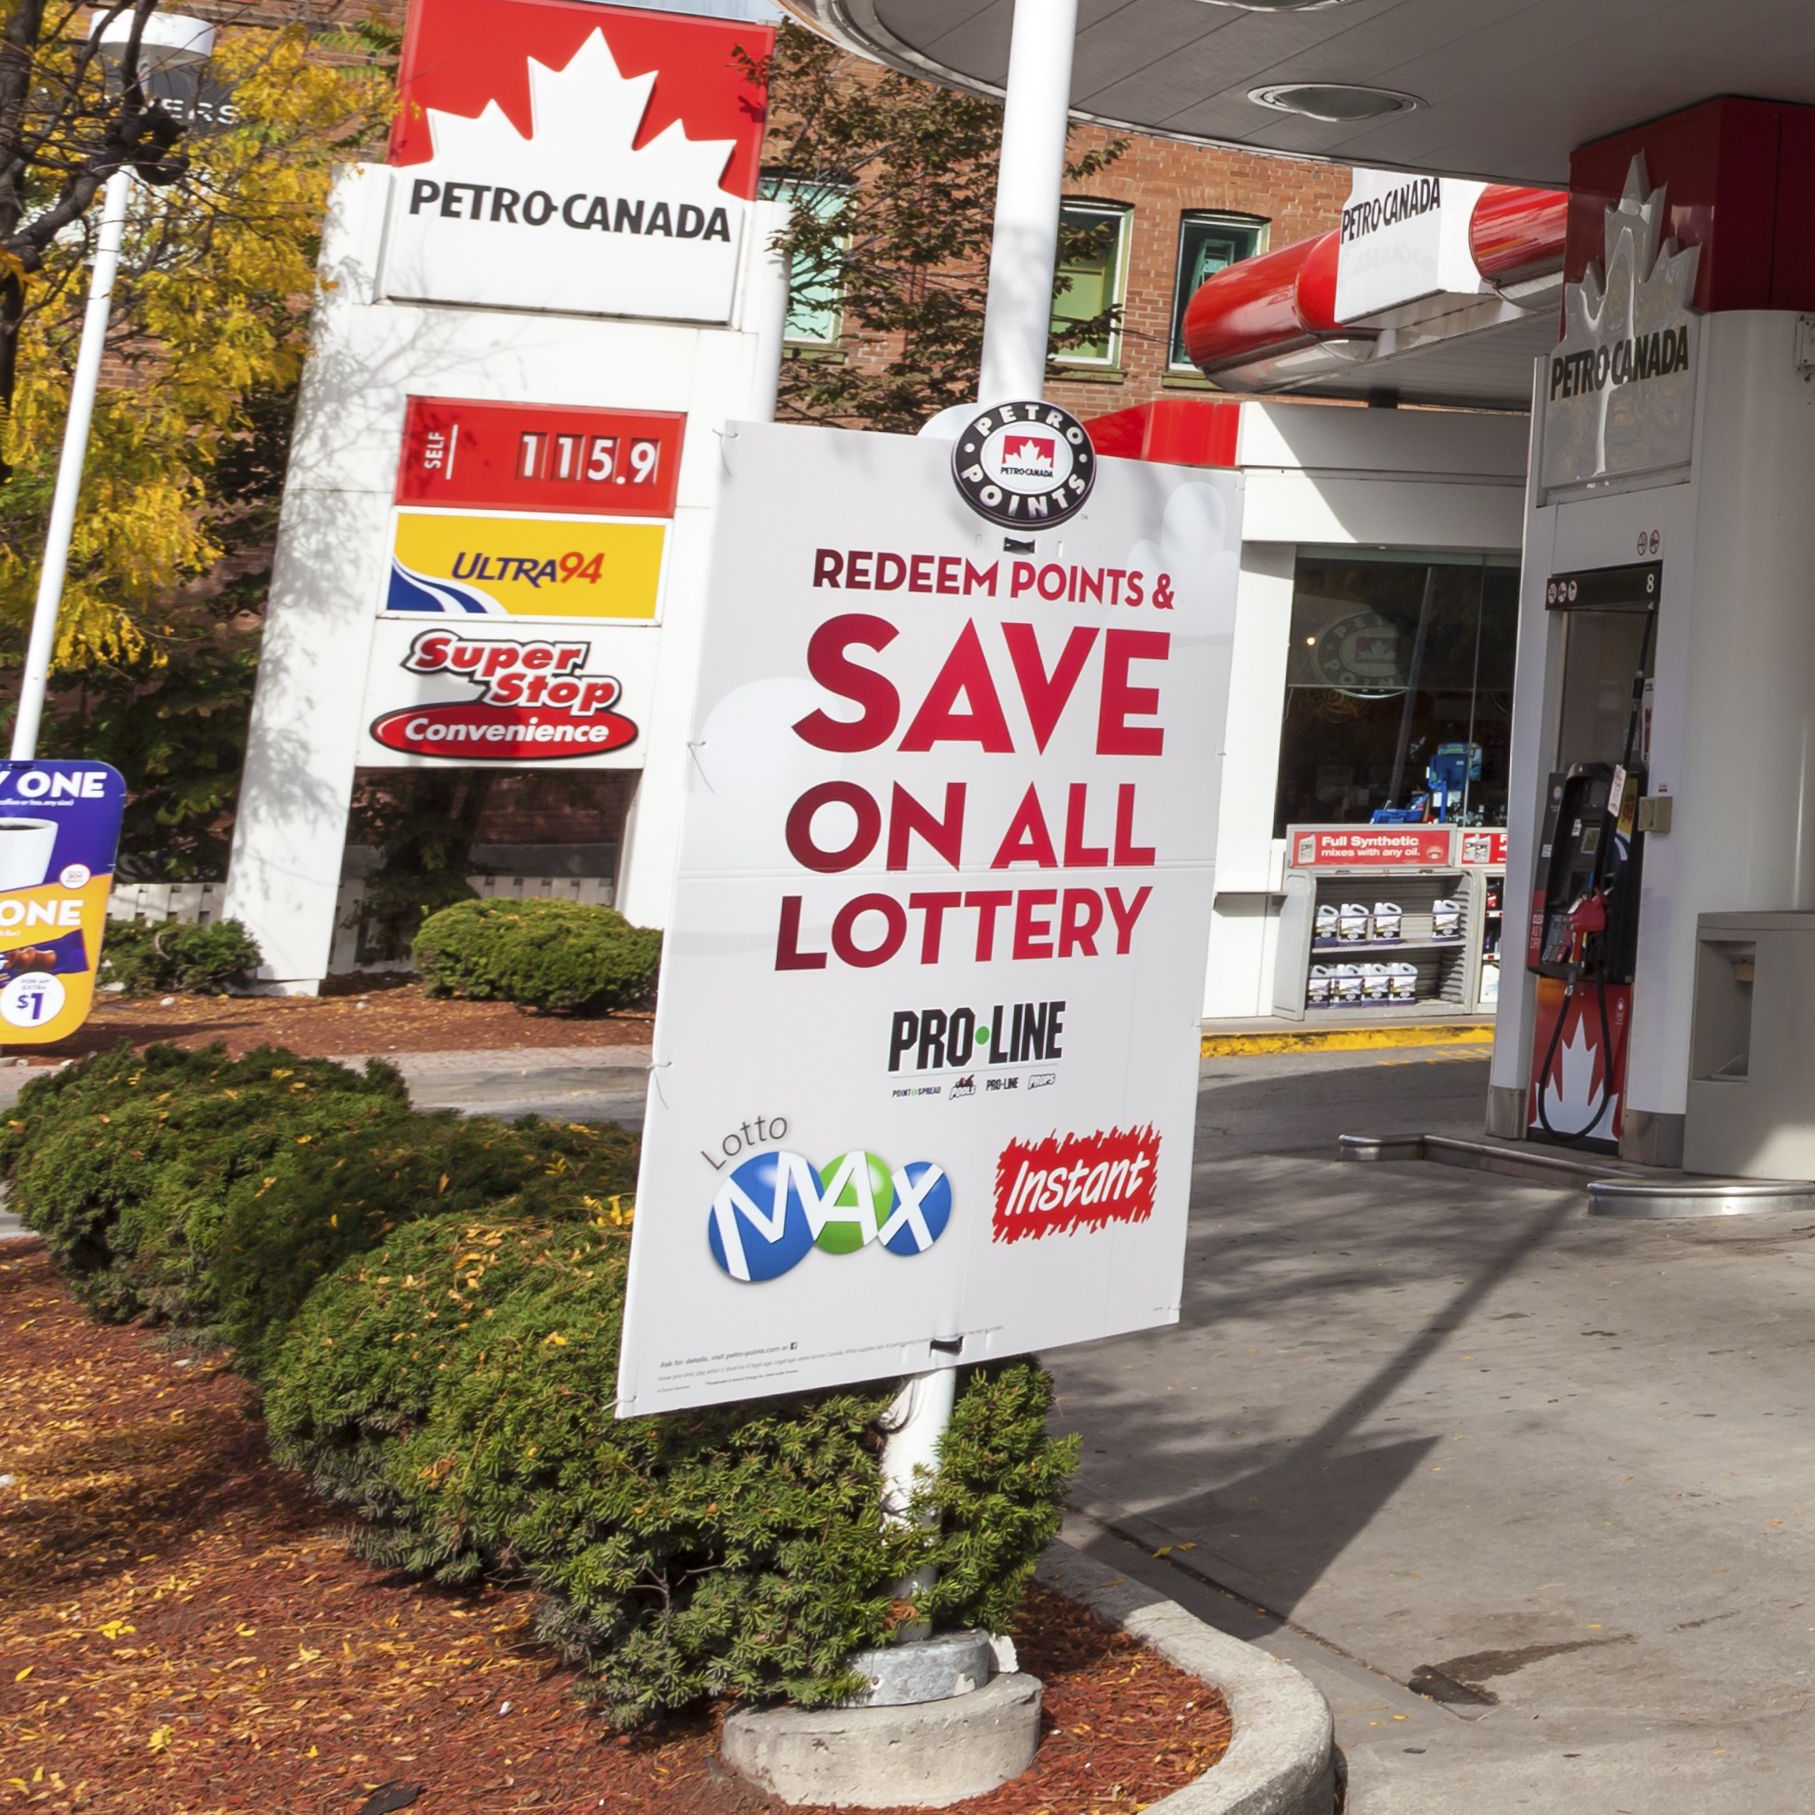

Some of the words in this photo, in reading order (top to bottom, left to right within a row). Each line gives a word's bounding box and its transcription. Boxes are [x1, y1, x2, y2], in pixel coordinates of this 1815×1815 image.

[973, 403, 1084, 445] PETRO
[424, 431, 446, 471] SELF
[521, 434, 657, 486] 115.9
[961, 463, 1086, 519] POINTS
[812, 548, 999, 598] REDEEM
[1010, 562, 1143, 609] POINTS
[1152, 576, 1175, 610] &
[1645, 573, 1655, 594] 8
[409, 632, 586, 680] Super
[490, 672, 618, 715] Stop
[791, 613, 1172, 757] SAVE
[404, 717, 609, 742] Convenience
[16, 770, 108, 798] ONE
[785, 780, 967, 874] ON
[990, 781, 1156, 870] ALL
[1321, 836, 1347, 846] Full
[1351, 835, 1419, 849] Synthetic
[1321, 848, 1355, 857] mixes
[1357, 847, 1380, 857] with
[1382, 848, 1402, 858] any
[1405, 847, 1421, 857] oil.
[0, 899, 85, 927] ONE
[775, 886, 1153, 971] LOTTERY
[16, 992, 44, 1020] $1
[701, 1115, 788, 1170] Lotto
[1005, 1150, 1150, 1217] Instant
[710, 1151, 946, 1281] MAX
